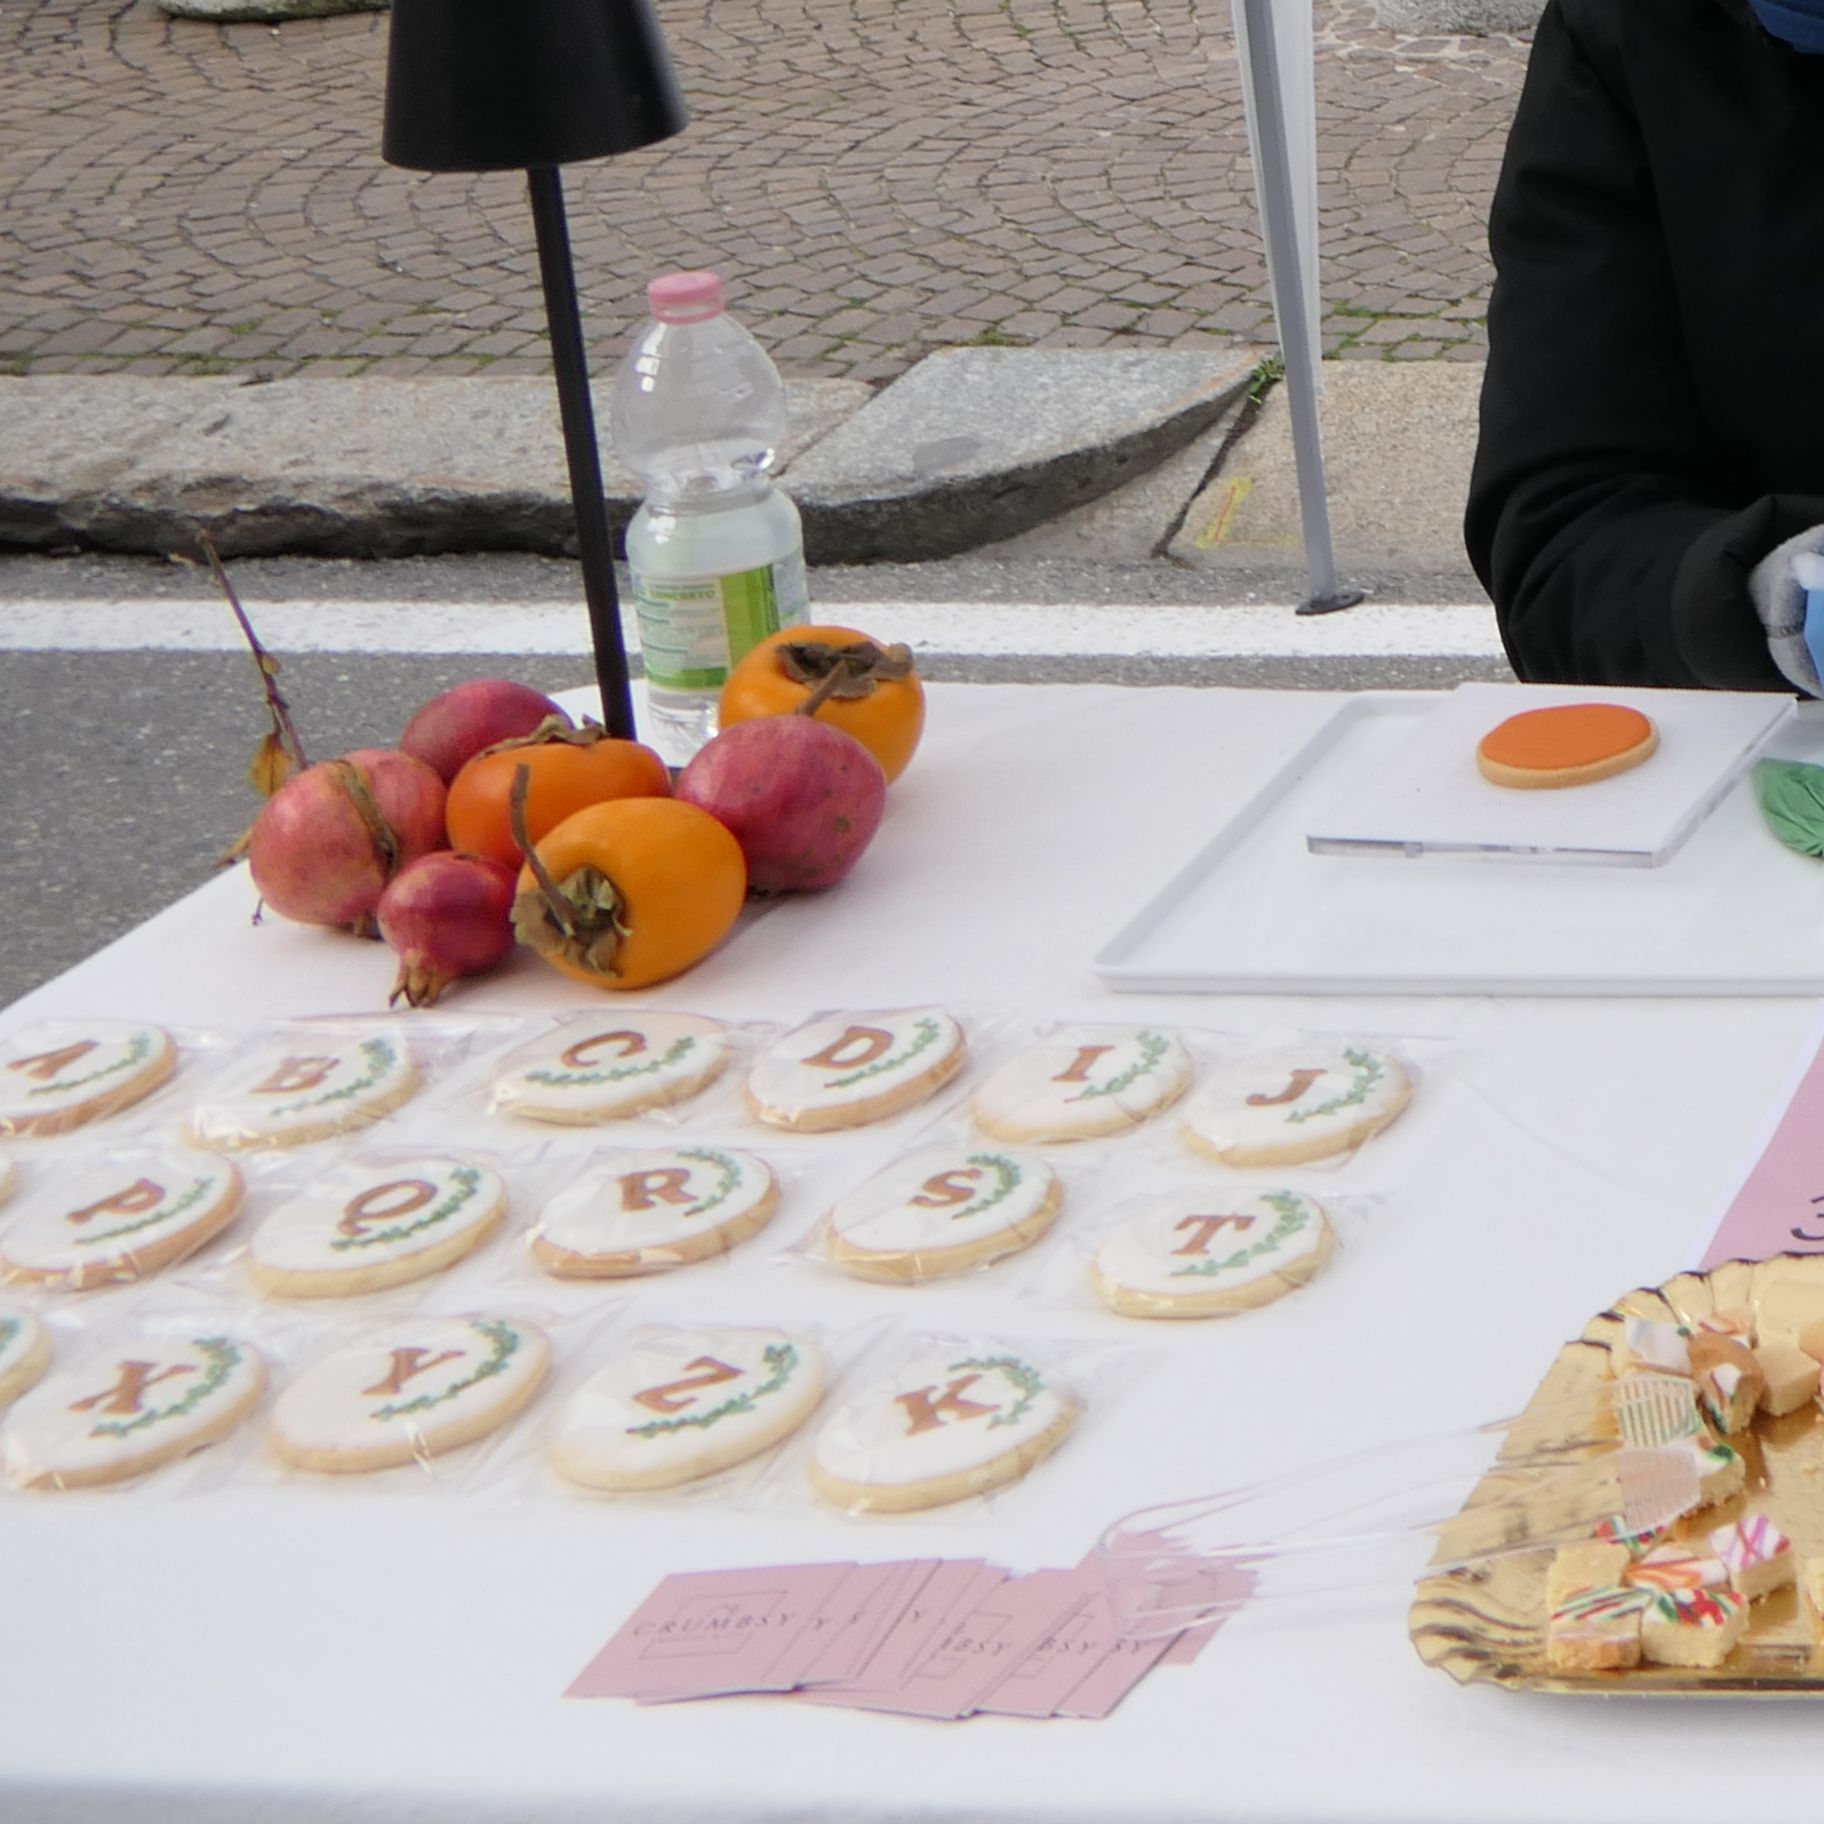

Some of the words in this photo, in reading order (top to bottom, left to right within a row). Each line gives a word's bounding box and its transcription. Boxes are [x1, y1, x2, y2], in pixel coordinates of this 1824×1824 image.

[561, 1031, 648, 1067] C
[800, 1025, 895, 1069] D
[1051, 1045, 1116, 1083] I
[1245, 1068, 1328, 1107] J
[66, 1179, 166, 1224] P
[618, 1168, 701, 1213] R
[910, 1169, 983, 1209] S
[1170, 1214, 1256, 1256] T
[67, 1360, 199, 1416] X
[361, 1347, 467, 1396] Y
[632, 1356, 745, 1413] Z
[894, 1375, 1001, 1438] K
